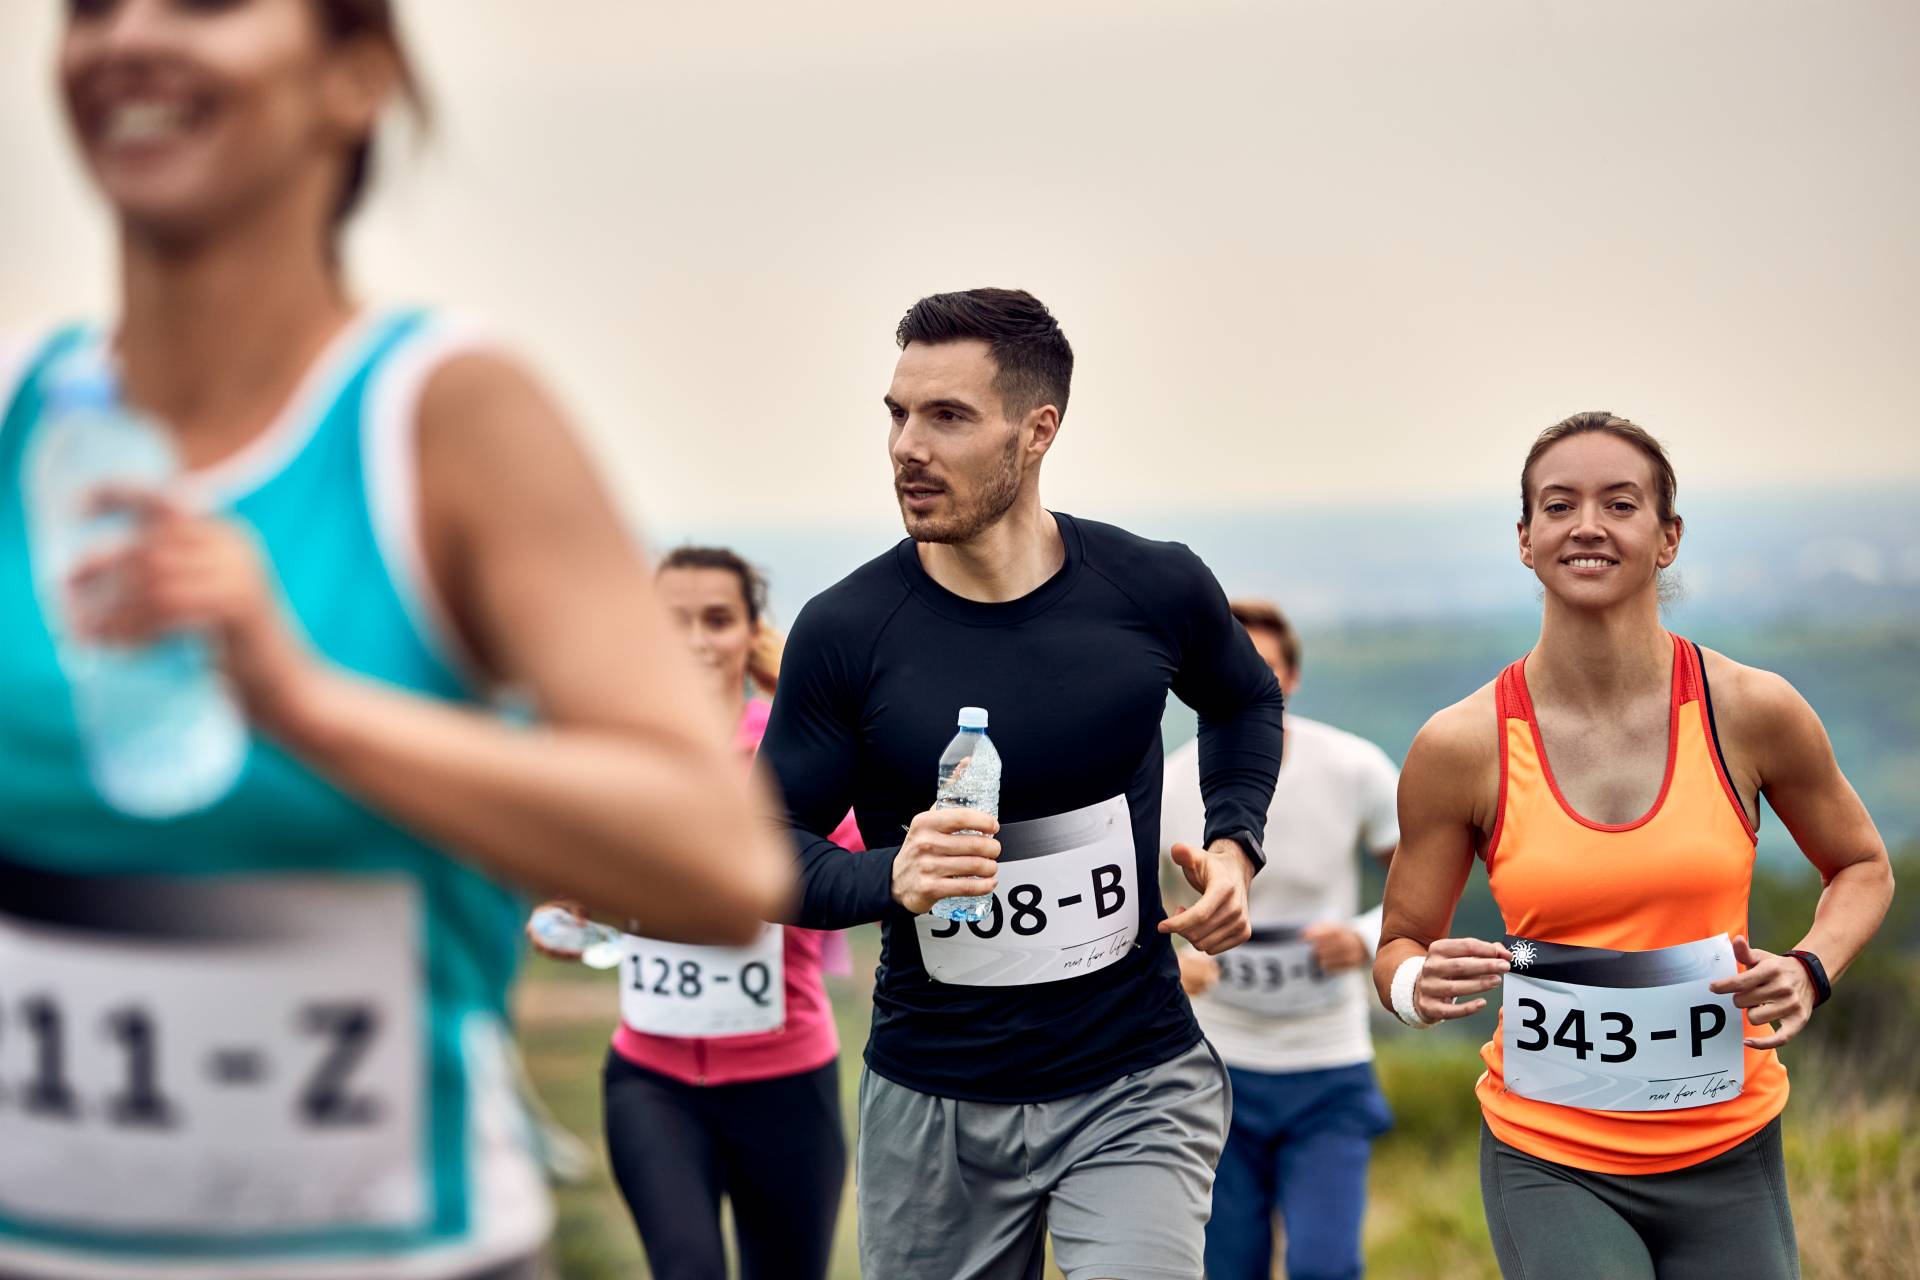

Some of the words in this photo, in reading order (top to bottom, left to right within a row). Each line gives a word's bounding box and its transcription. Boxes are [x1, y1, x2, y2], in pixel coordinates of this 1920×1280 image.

[631, 955, 771, 1007] 128-Q
[1087, 947, 1104, 968] for
[1516, 997, 1727, 1063] 343-P
[0, 994, 384, 1131] 11-Z
[1649, 1092, 1671, 1101] run
[1673, 1084, 1697, 1104] for
[1702, 1076, 1729, 1098] life
